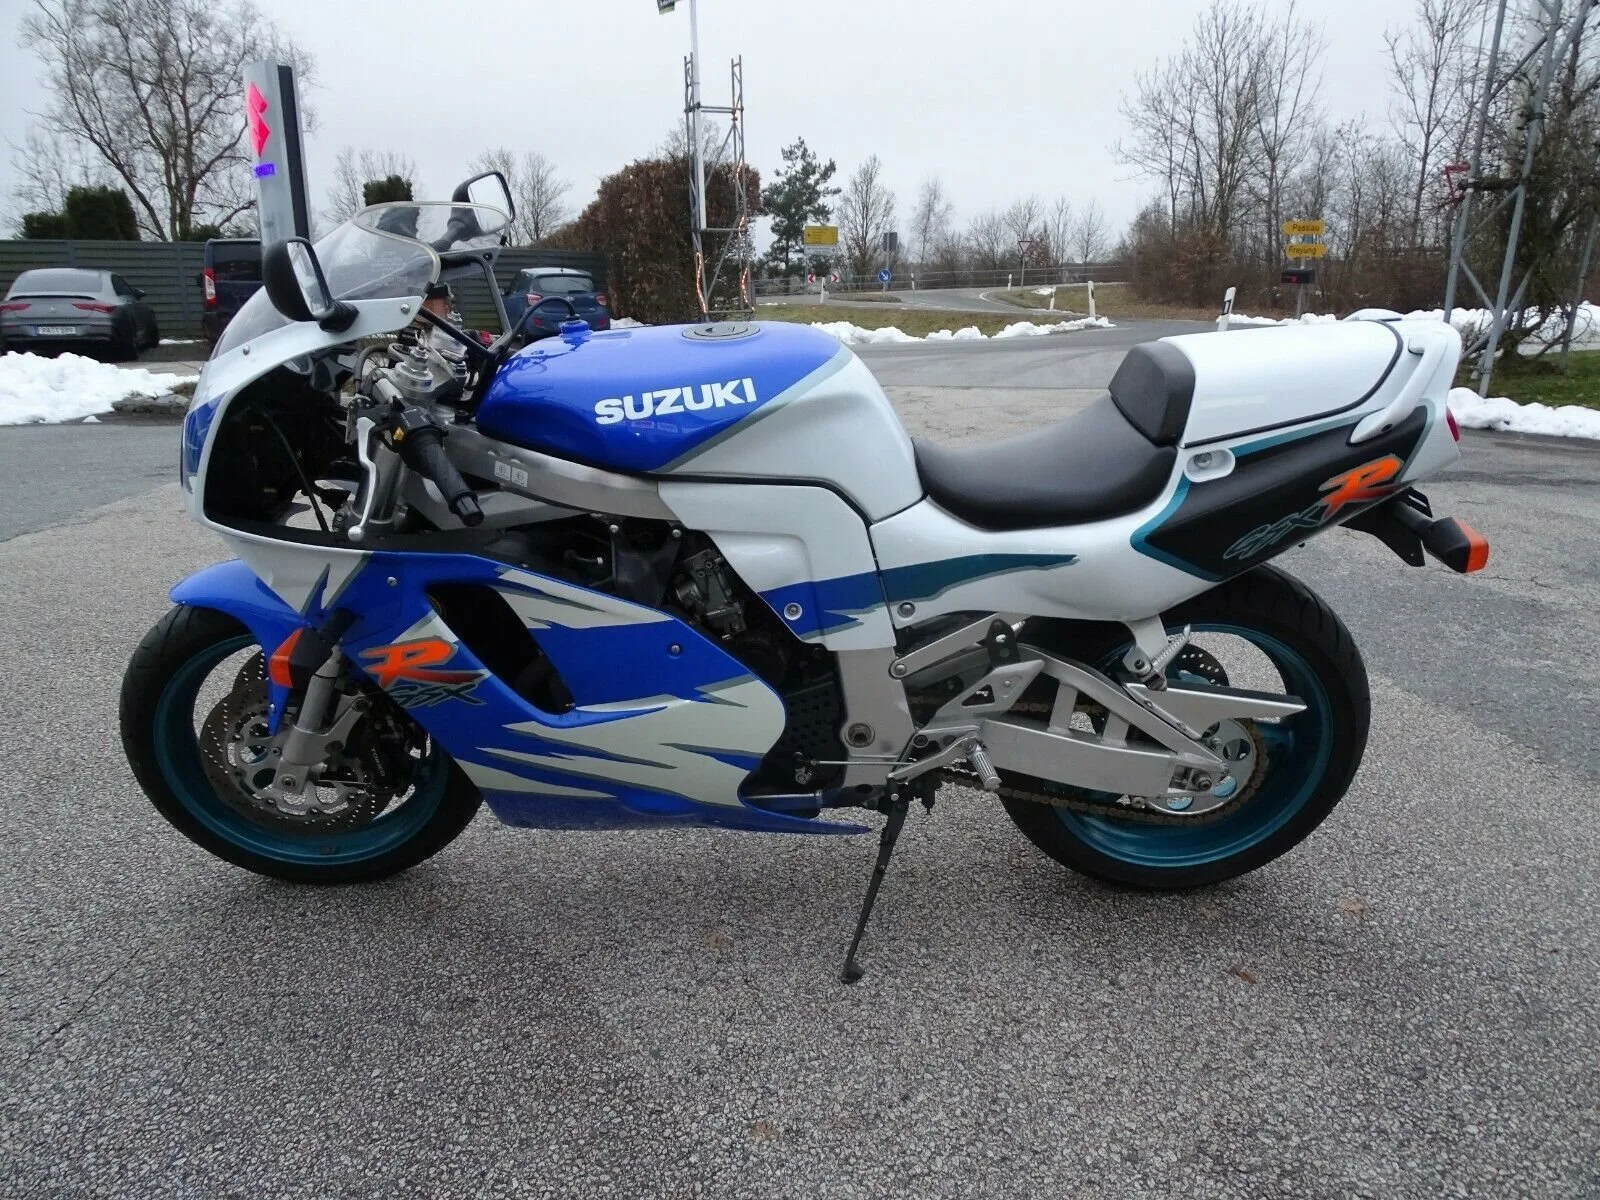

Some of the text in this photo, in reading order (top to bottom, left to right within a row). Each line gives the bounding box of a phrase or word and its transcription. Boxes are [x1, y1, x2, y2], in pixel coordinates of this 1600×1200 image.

[1291, 223, 1321, 232] Passau
[1288, 245, 1317, 256] Freyung
[594, 377, 757, 425] SUZUKI
[358, 635, 492, 691] R
